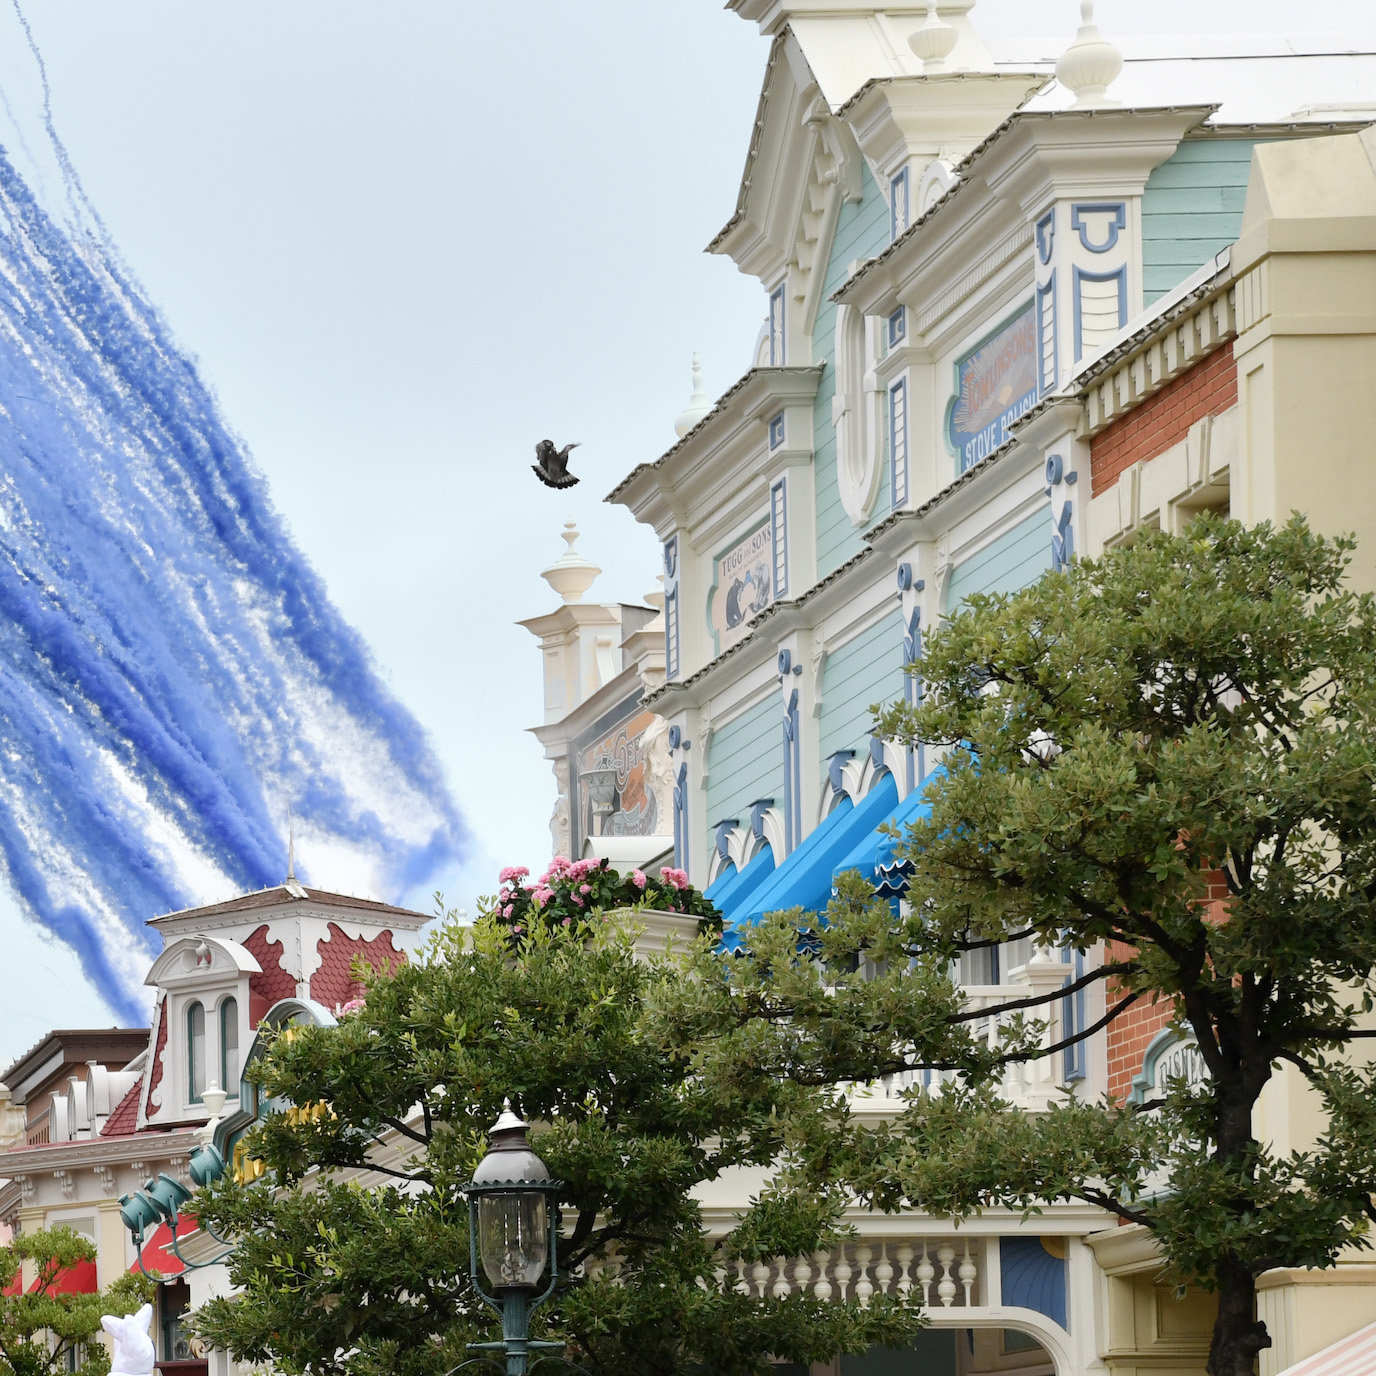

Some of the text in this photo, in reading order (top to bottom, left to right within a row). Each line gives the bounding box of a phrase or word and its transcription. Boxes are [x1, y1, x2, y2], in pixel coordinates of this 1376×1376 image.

[965, 422, 997, 469] STOVE
[722, 549, 743, 577] TUGG
[751, 525, 772, 553] SONS
[1159, 1047, 1205, 1094] DISNEY
